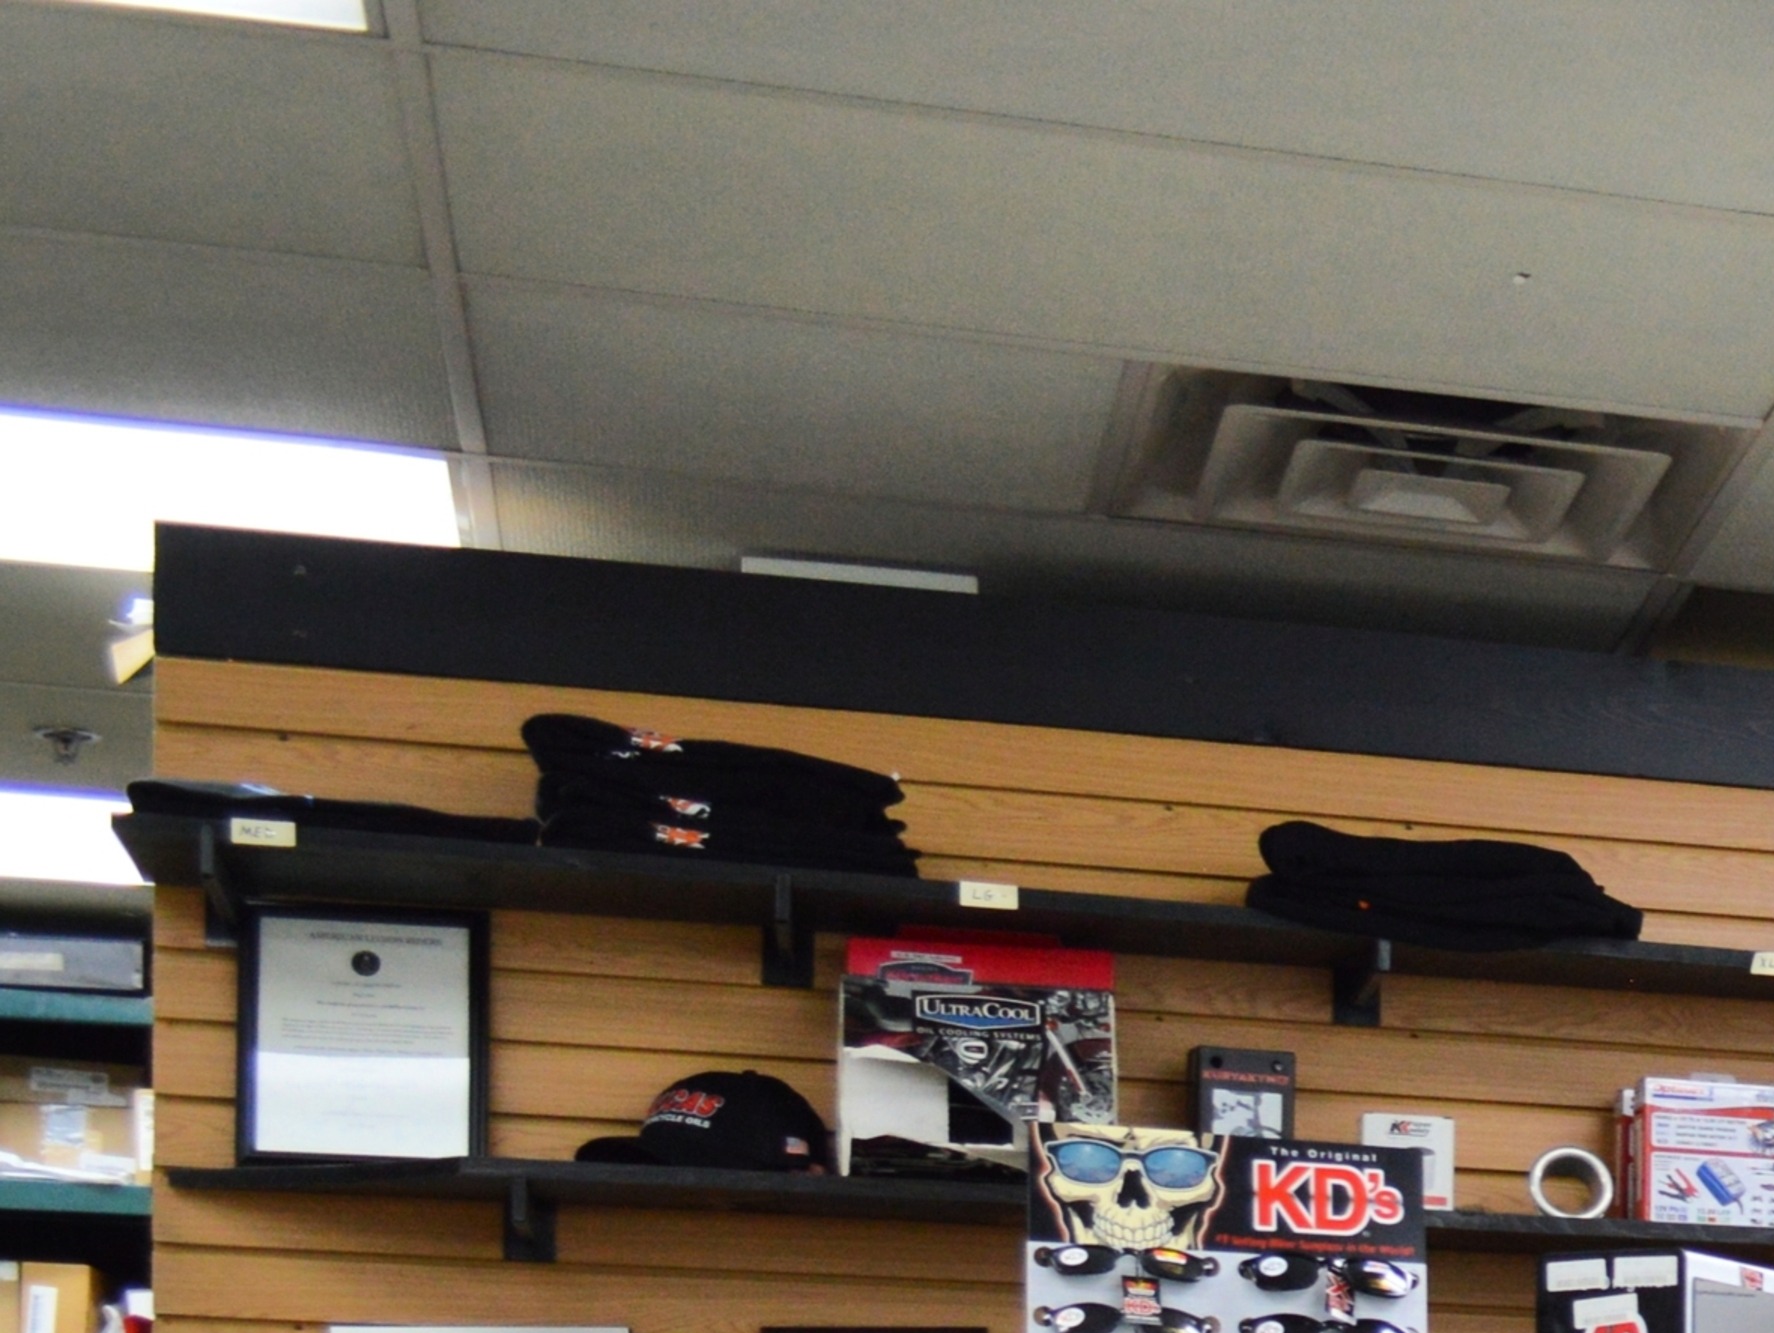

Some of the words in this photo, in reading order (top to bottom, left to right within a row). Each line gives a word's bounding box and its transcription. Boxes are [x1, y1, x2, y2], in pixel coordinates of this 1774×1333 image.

[1270, 1146, 1299, 1158] The
[1306, 1149, 1379, 1163] Original
[1252, 1158, 1405, 1237] KD's
